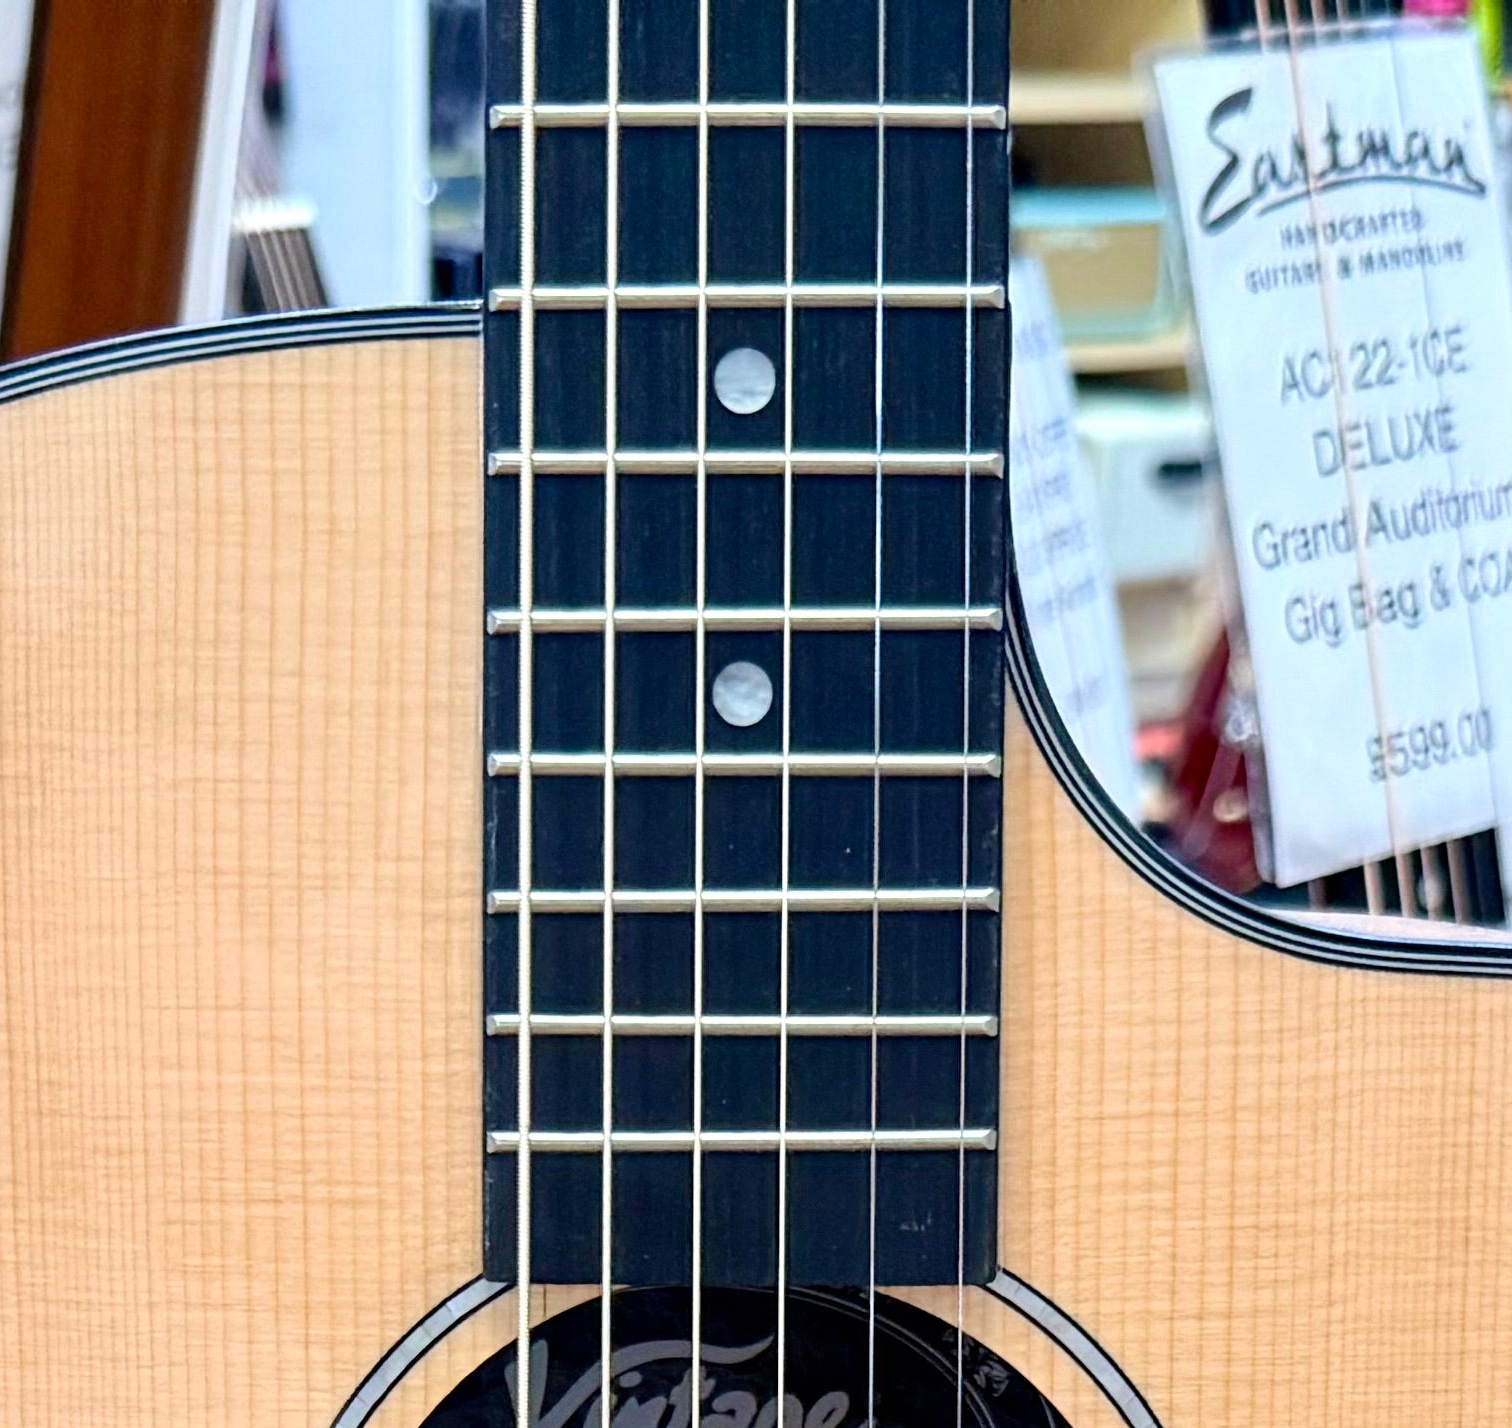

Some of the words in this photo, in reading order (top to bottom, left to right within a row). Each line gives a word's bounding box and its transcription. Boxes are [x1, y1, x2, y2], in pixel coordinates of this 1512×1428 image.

[1312, 403, 1459, 477] DELUXE
[1251, 506, 1353, 571] Grand
[1284, 594, 1344, 648] Gig
[1348, 578, 1423, 630] Bag
[1429, 561, 1451, 612] &
